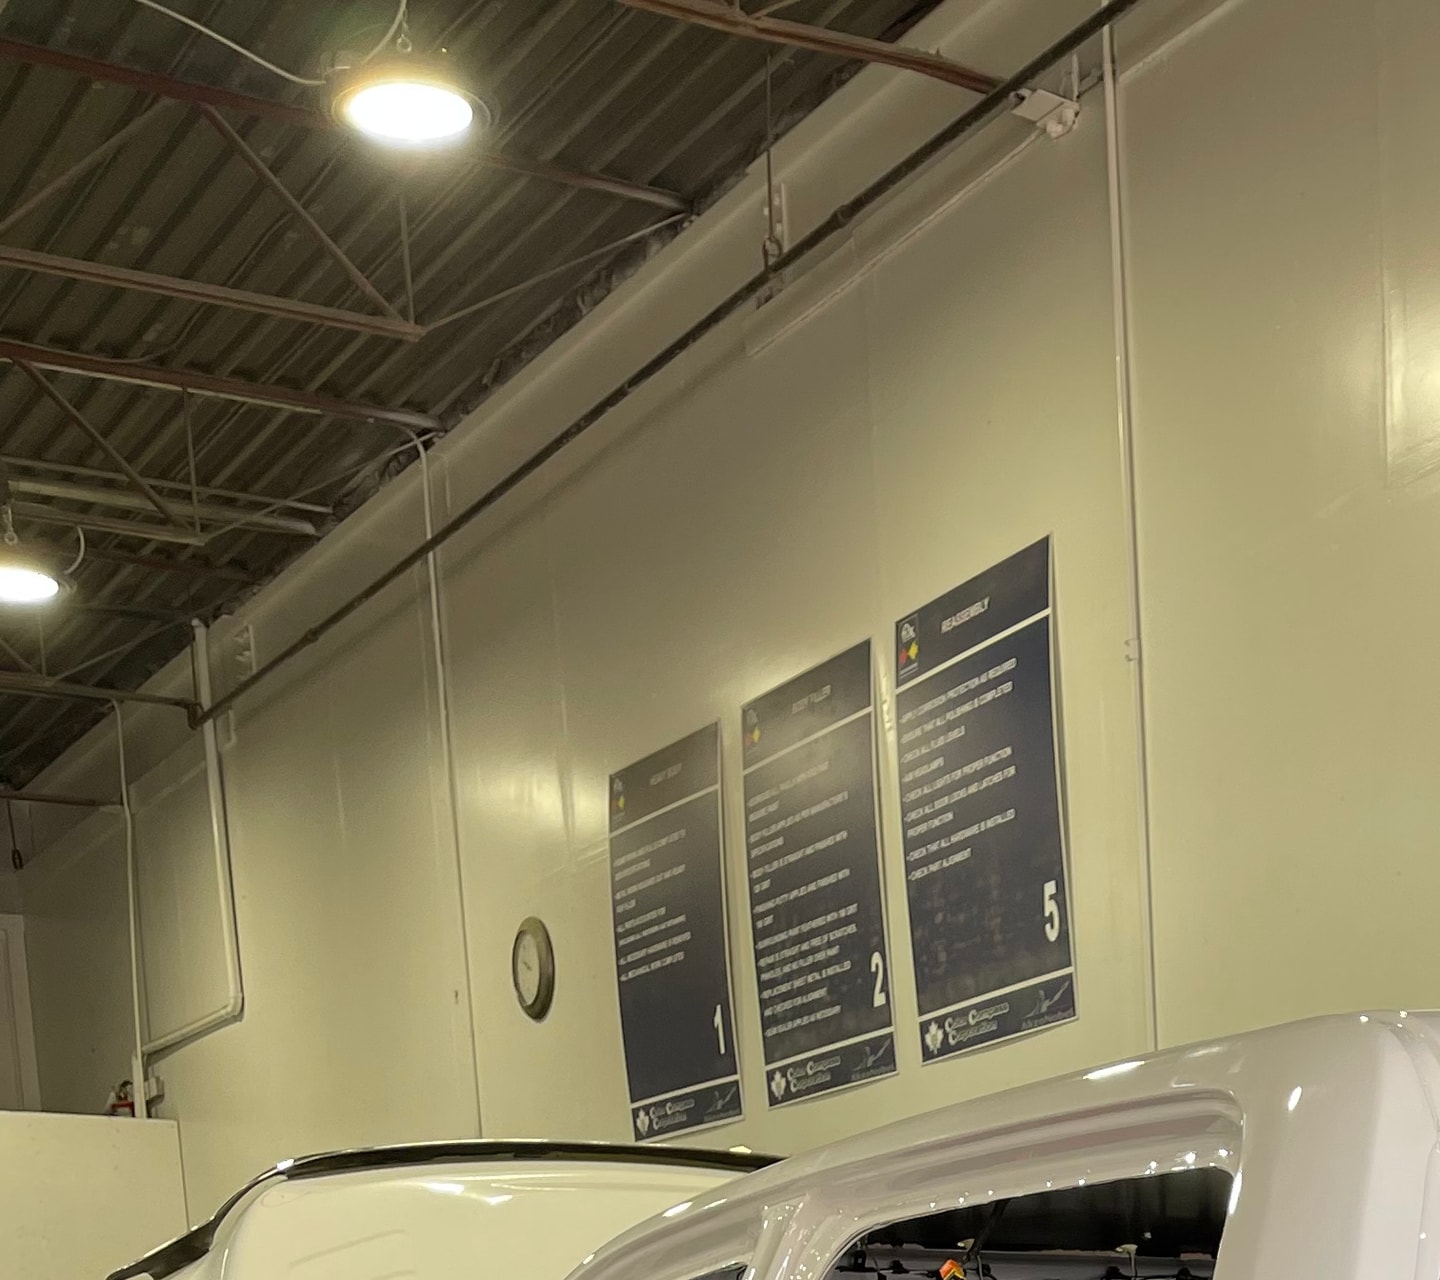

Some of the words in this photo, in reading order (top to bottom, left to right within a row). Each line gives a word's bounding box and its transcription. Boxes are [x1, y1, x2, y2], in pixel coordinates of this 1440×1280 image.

[941, 596, 989, 632] REASSEMBLY
[1042, 879, 1060, 942] 5
[869, 949, 885, 1006] 2
[714, 1004, 725, 1055] 1
